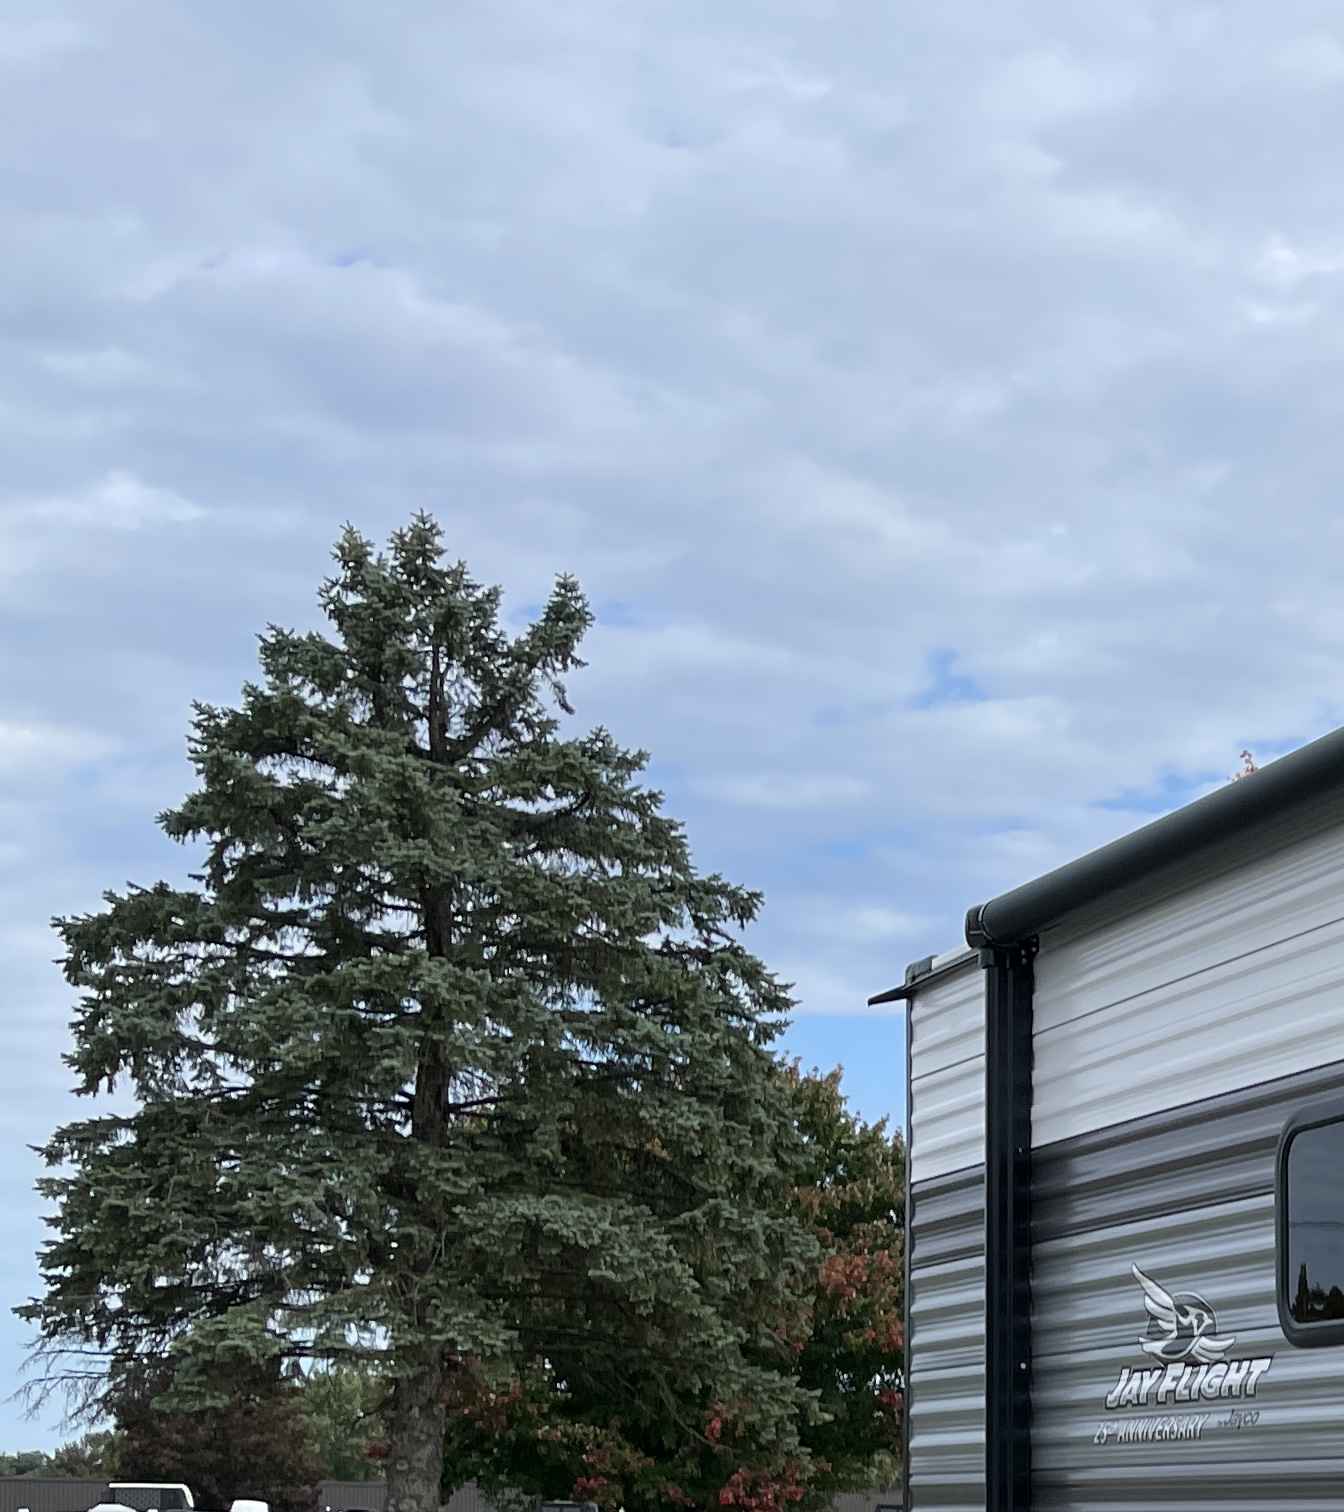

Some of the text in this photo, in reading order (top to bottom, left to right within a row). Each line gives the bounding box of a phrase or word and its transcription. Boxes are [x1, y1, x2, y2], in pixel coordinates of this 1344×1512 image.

[1105, 1355, 1274, 1409] JAY FLIGHT
[1117, 1413, 1211, 1444] ANNIVERSARY
